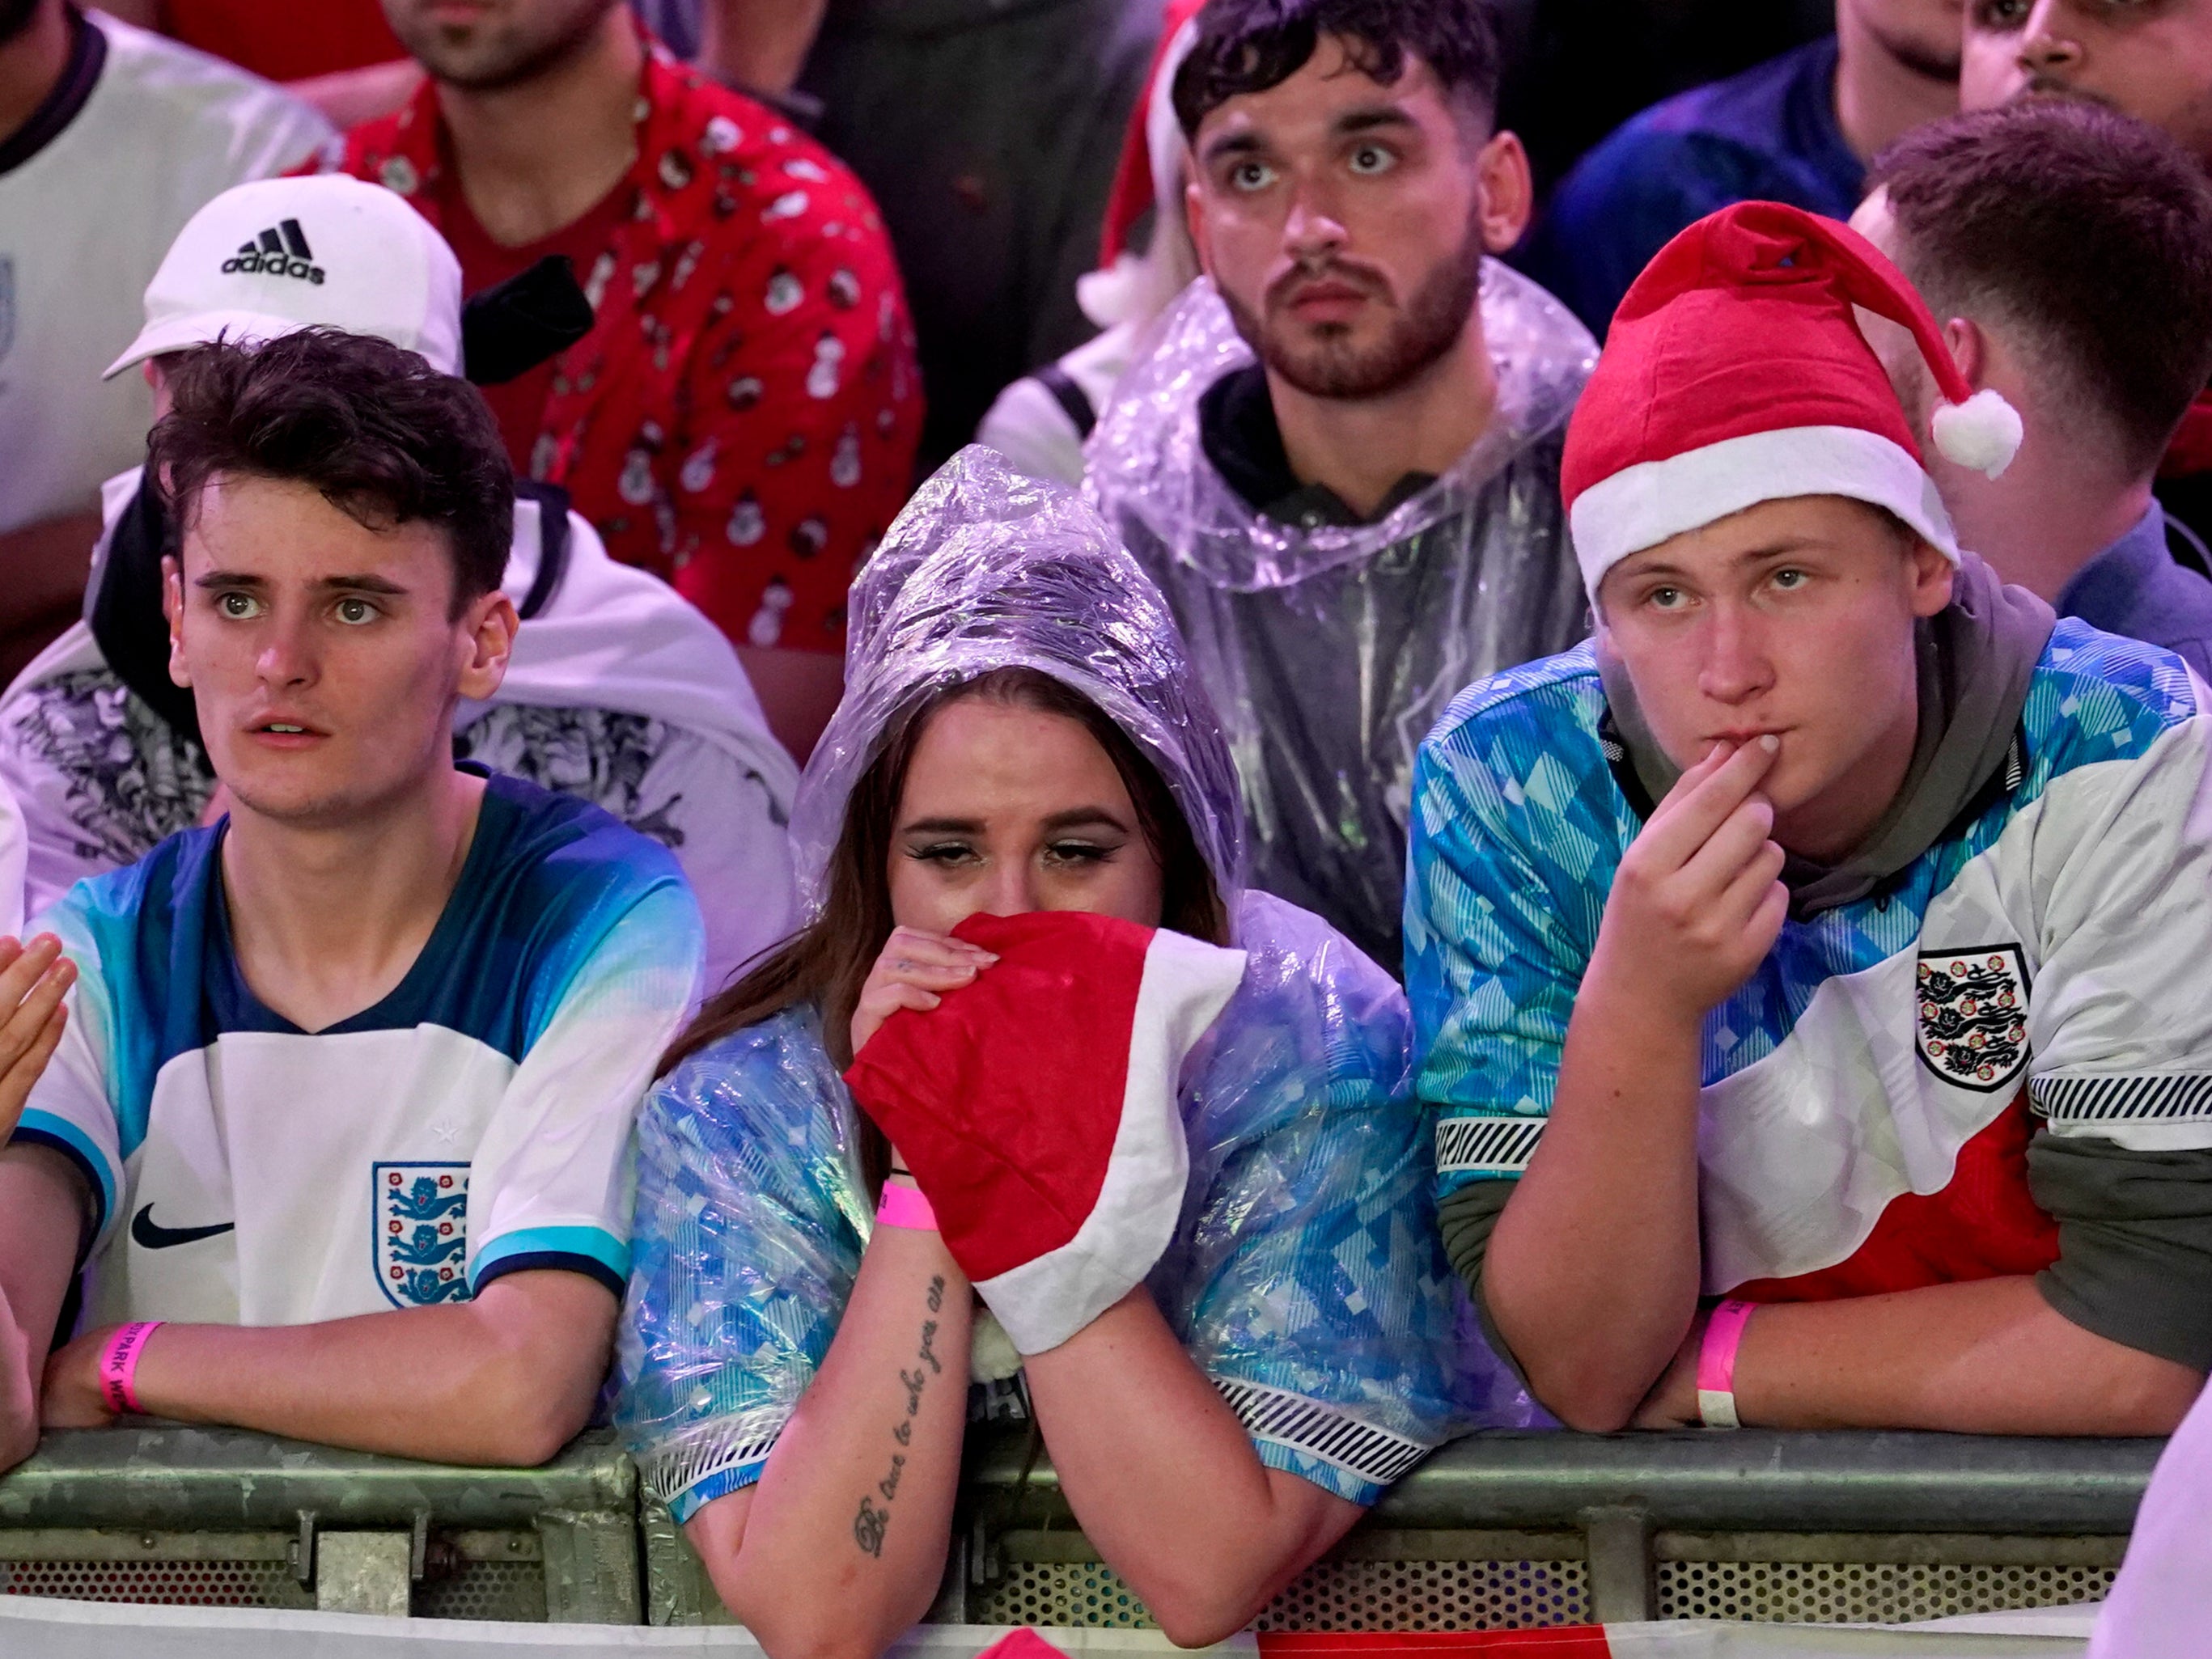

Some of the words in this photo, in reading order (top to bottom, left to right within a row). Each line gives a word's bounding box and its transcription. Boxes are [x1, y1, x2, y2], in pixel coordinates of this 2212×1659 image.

[221, 252, 325, 285] adidas
[919, 1319, 942, 1374] you
[900, 1368, 925, 1416] who
[892, 1419, 912, 1447] to
[854, 1495, 889, 1559] Be
